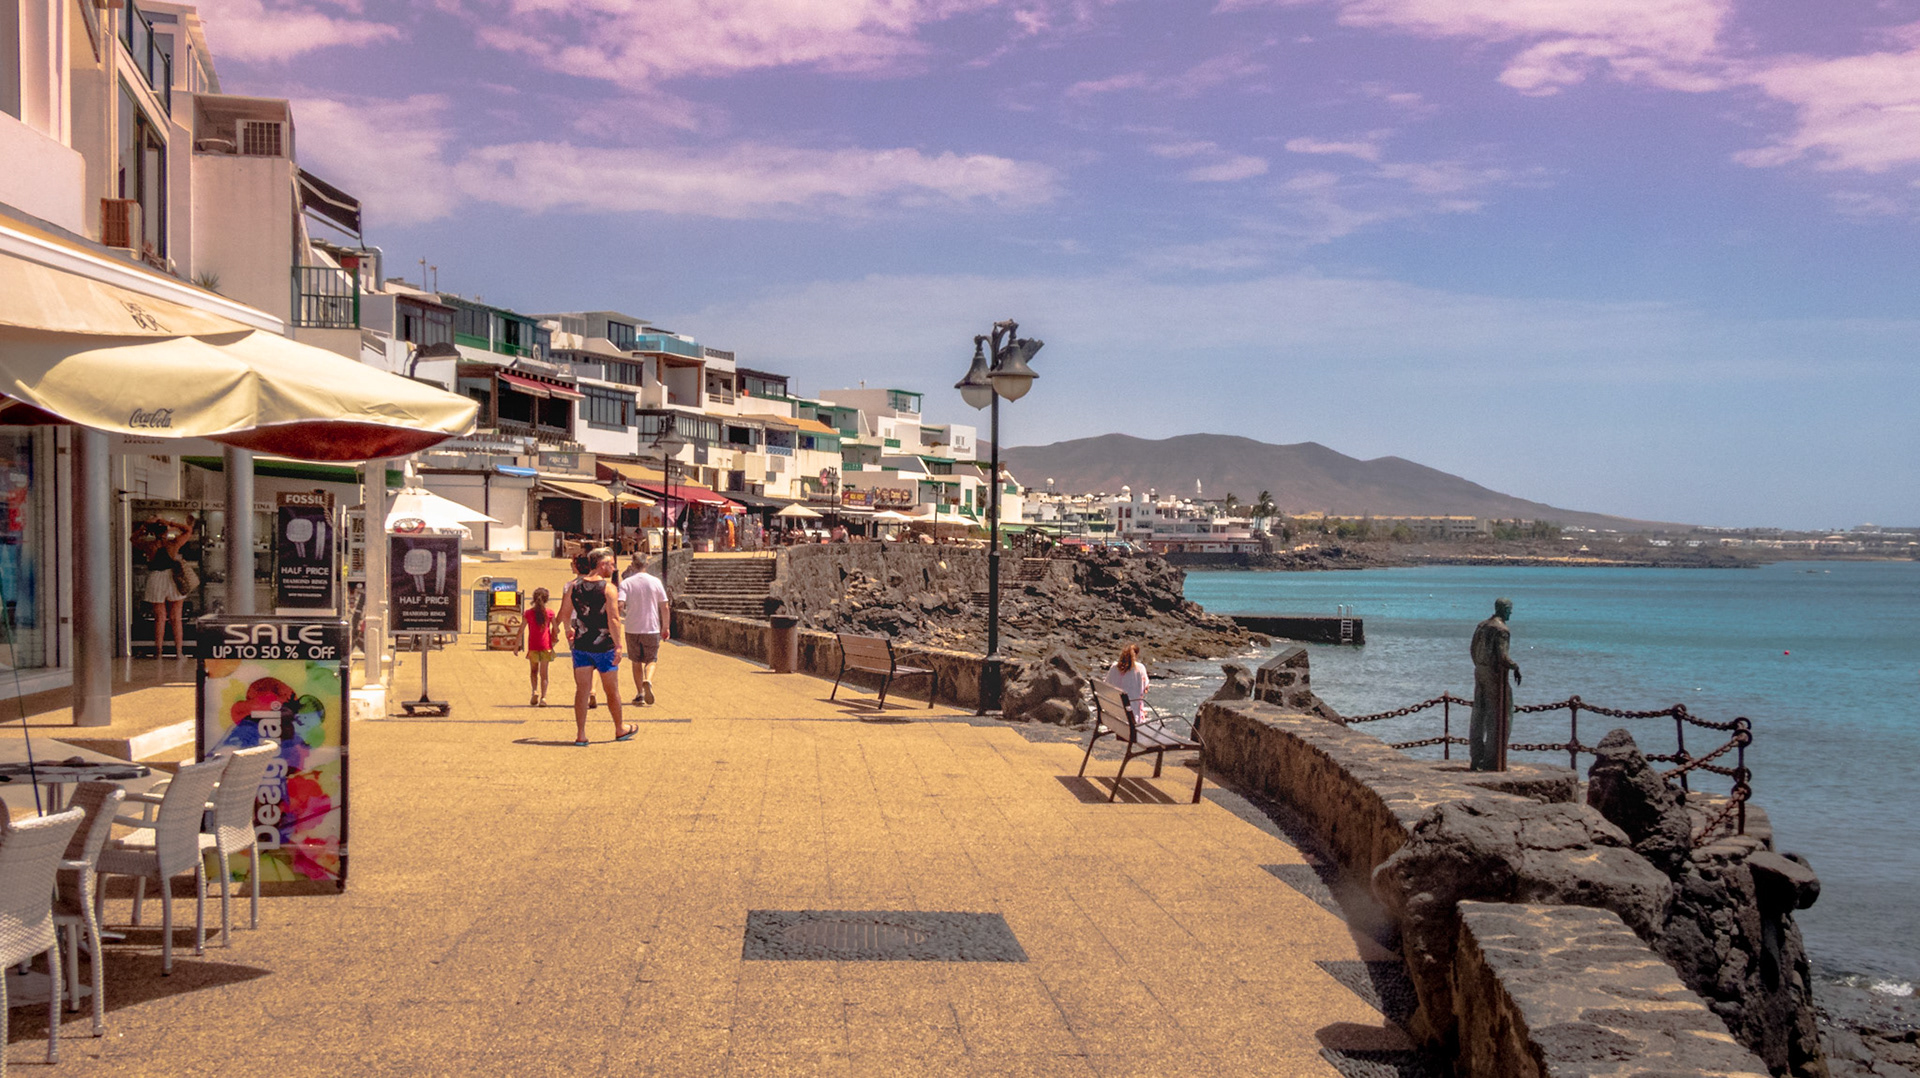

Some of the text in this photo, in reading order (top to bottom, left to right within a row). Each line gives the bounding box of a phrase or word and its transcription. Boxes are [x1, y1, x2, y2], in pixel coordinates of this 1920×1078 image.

[285, 494, 325, 505] FOSSIL
[281, 566, 329, 576] HALF PRICE
[399, 596, 449, 605] HALF PRICE
[224, 623, 323, 645] SALE
[212, 645, 335, 659] UP TO 50 % OFF
